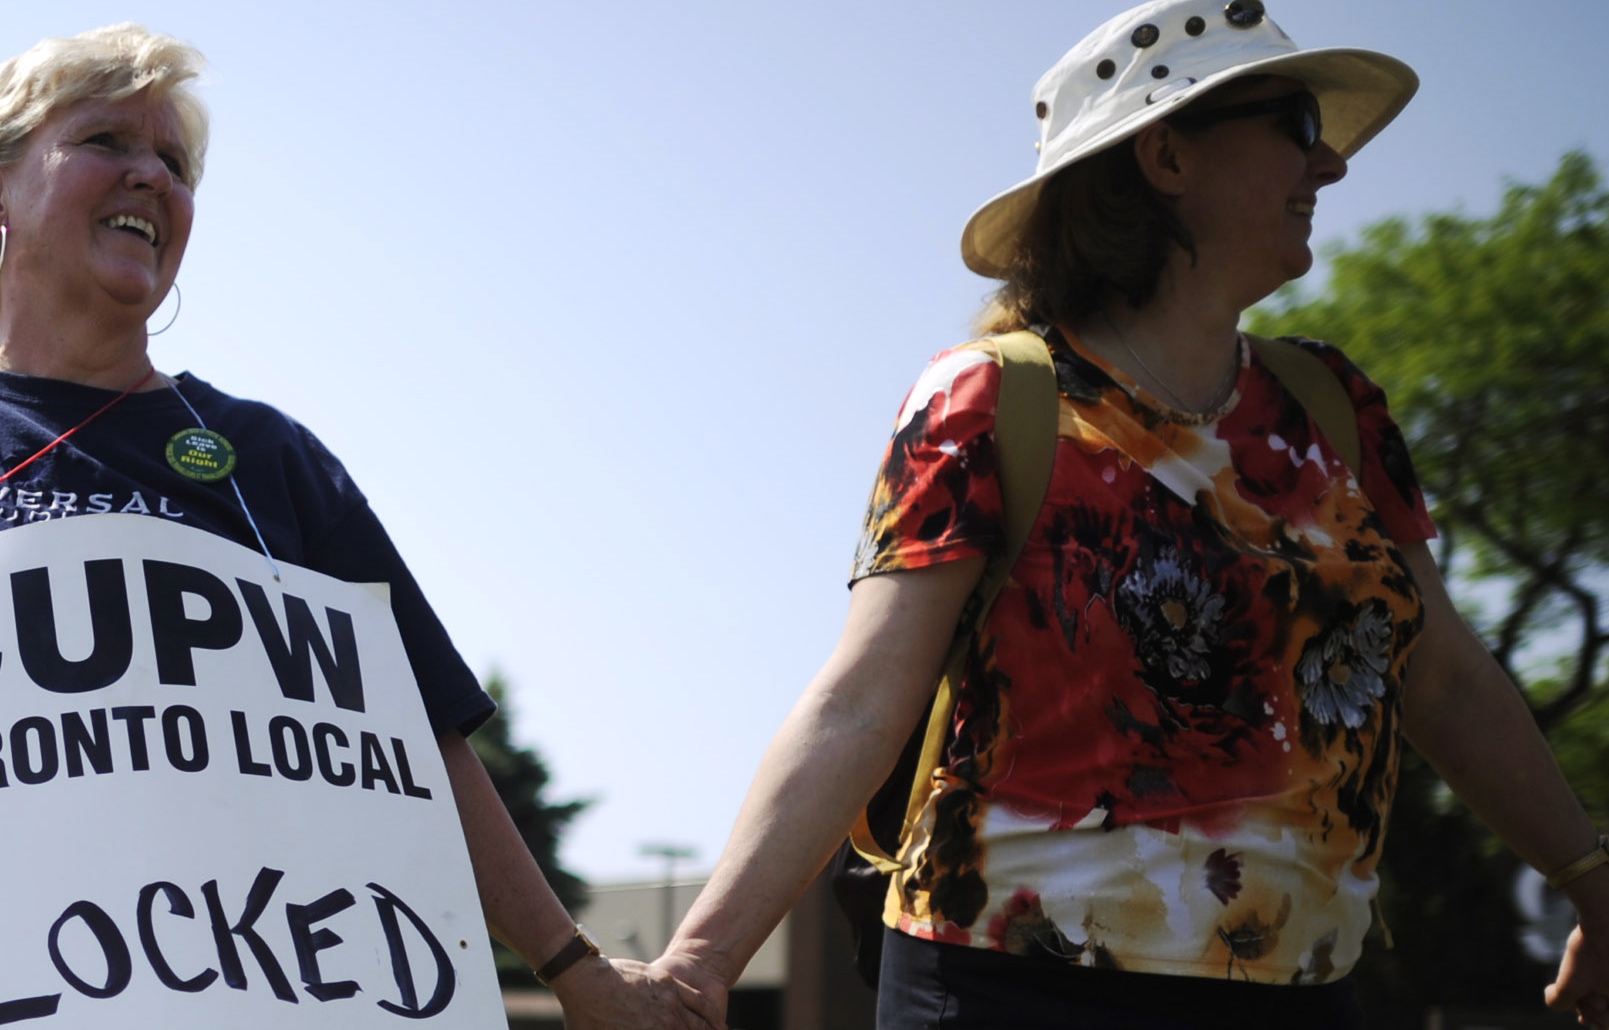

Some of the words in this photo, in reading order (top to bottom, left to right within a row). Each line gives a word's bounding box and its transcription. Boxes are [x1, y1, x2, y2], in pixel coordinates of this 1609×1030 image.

[188, 449, 213, 459] Our
[180, 455, 218, 469] Right
[230, 710, 433, 800] LOCAL
